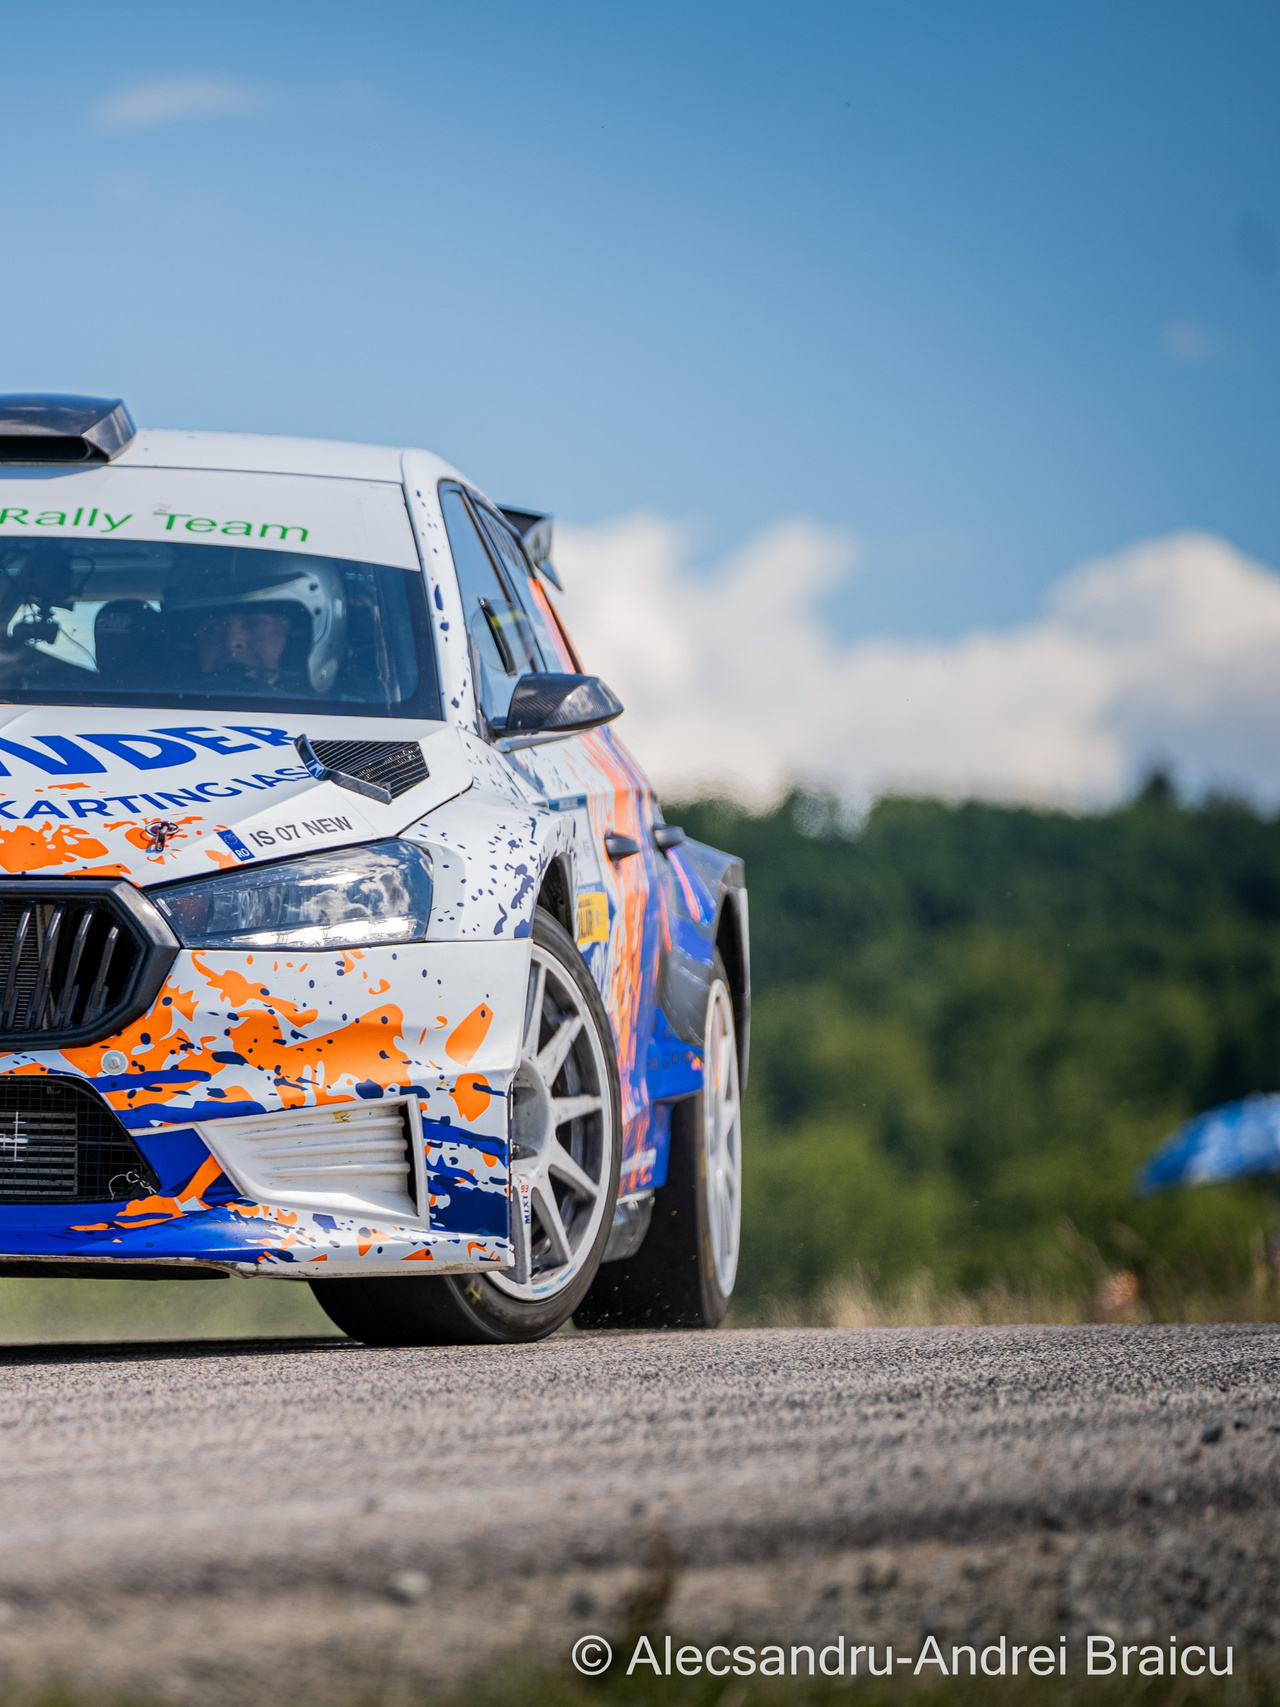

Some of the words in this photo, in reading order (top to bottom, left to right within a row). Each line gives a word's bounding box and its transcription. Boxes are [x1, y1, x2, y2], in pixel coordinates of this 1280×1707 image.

[154, 512, 308, 542] Team
[249, 830, 277, 847] IS
[275, 823, 302, 841] 07
[301, 815, 353, 836] NEW
[234, 847, 250, 858] RO
